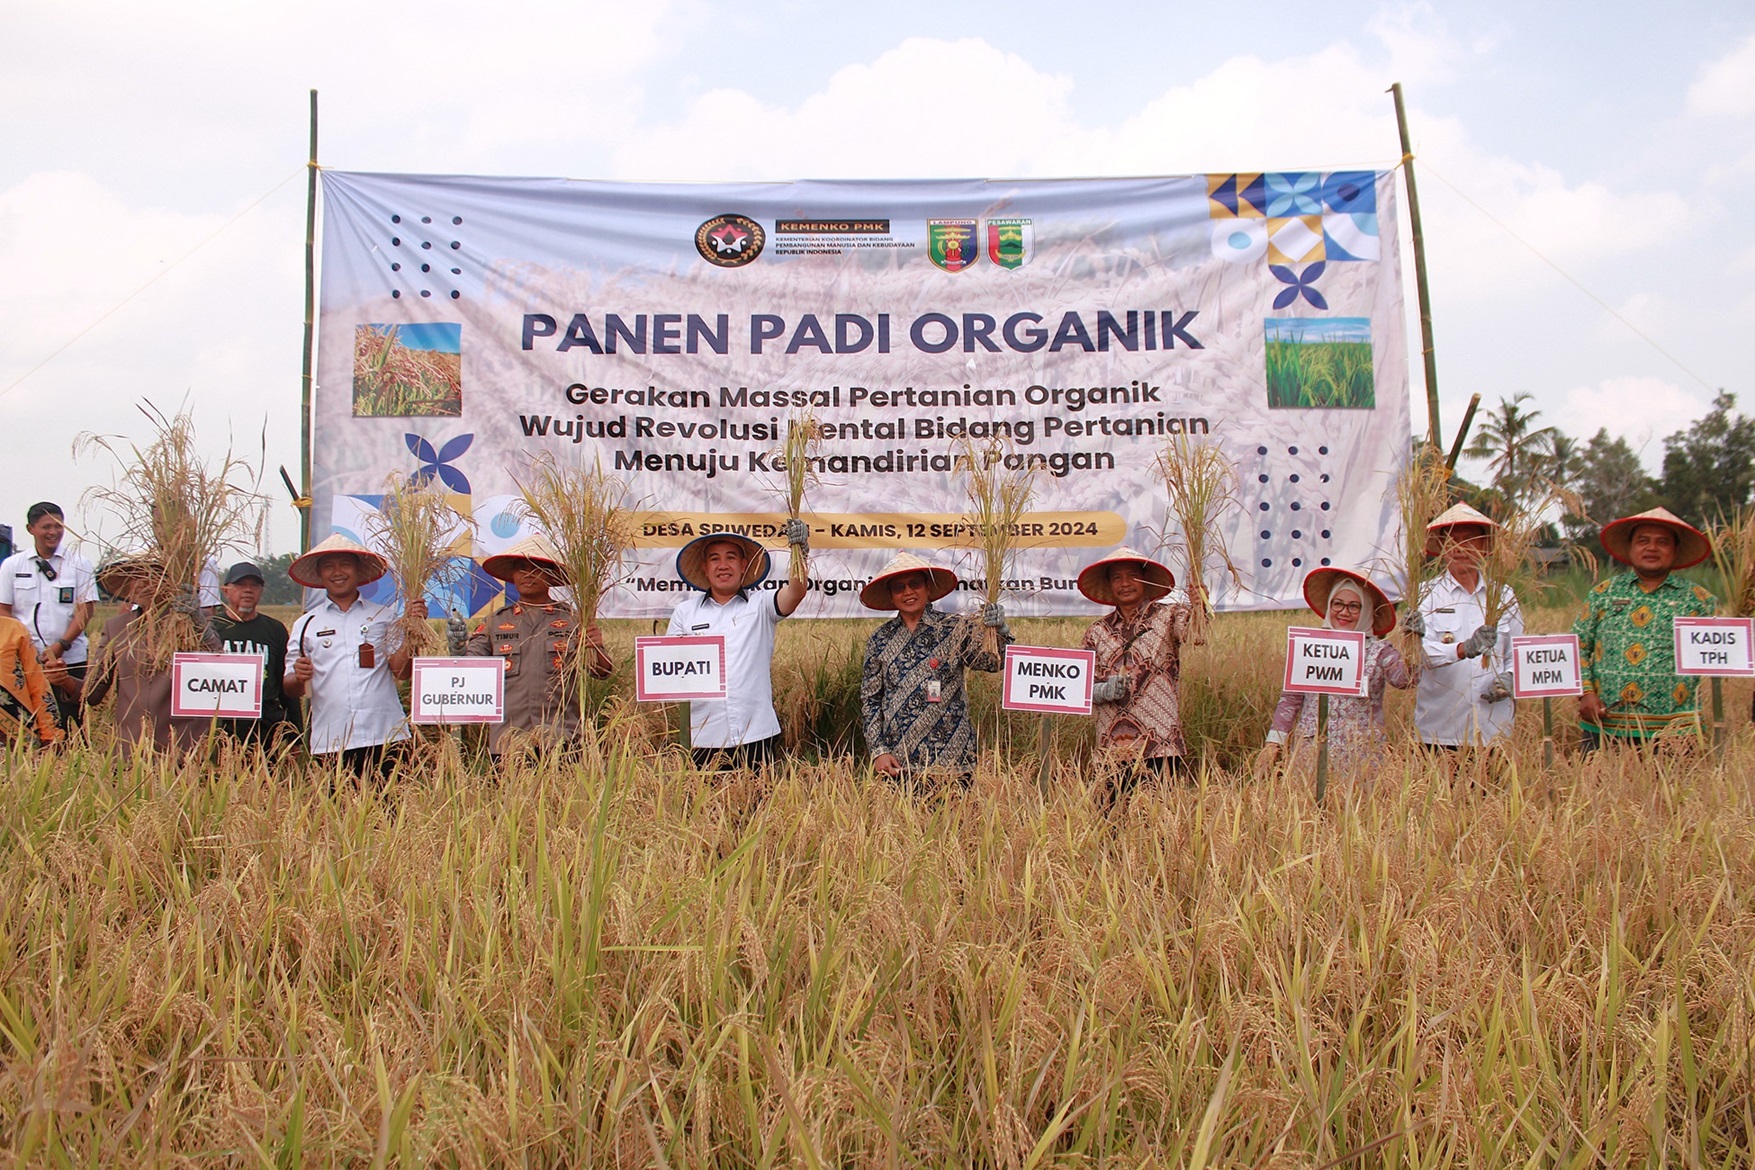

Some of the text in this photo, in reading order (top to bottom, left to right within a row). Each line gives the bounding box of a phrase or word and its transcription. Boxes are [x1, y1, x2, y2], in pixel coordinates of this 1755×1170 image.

[781, 223, 884, 231] KEMENKO PMK
[521, 310, 1206, 355] PANEN PADI ORGANIK
[565, 380, 1161, 412] Gerakan Massal Pertanian Organik
[518, 414, 626, 444] Wujud
[635, 416, 779, 441] Revolusi
[914, 416, 1035, 446] Bidang
[1043, 411, 1209, 438] Pertanian
[614, 448, 739, 479] Menuju
[983, 450, 1115, 478] Pangan
[642, 522, 695, 537] DESA
[699, 522, 810, 538] SRIWEDAI
[831, 522, 902, 540] KAMIS,
[906, 523, 926, 538] 12
[1049, 521, 1098, 536] 2024
[495, 632, 520, 641] TIMUR
[1691, 632, 1736, 645] KADIS
[1303, 643, 1350, 660] KETUA
[1526, 649, 1568, 664] KETUA
[1699, 651, 1728, 665] TPH
[652, 660, 711, 676] BUPATI
[1017, 661, 1080, 680] MENKO
[1305, 665, 1343, 681] PWM
[187, 678, 248, 693] CAMAT
[451, 677, 465, 688] PJ
[1532, 670, 1563, 685] MPM
[422, 693, 494, 705] GUBERNUR
[1029, 684, 1066, 700] PMK
